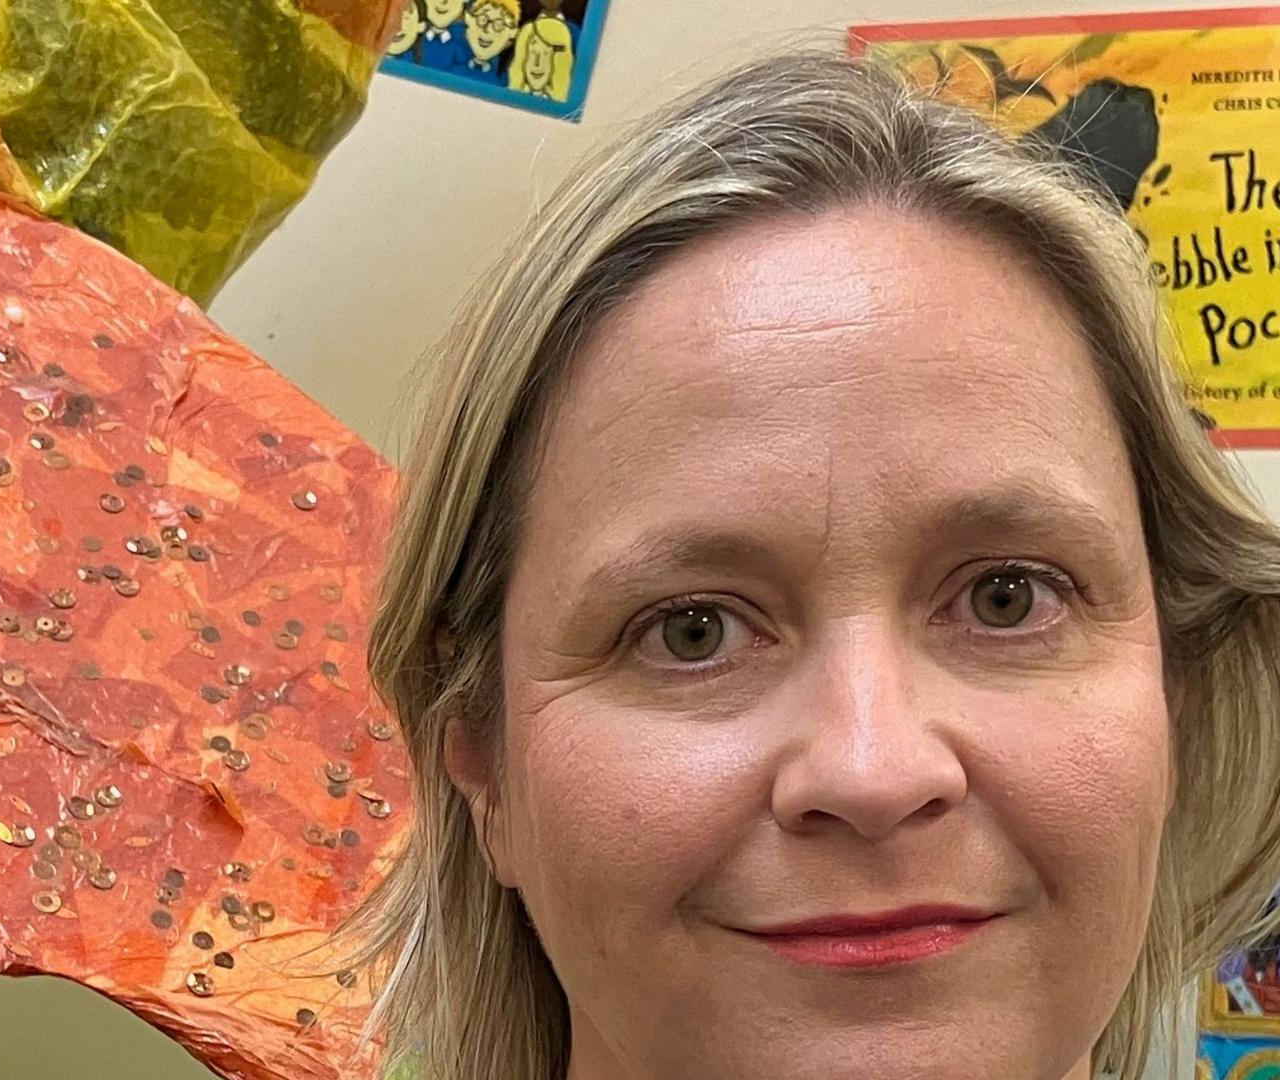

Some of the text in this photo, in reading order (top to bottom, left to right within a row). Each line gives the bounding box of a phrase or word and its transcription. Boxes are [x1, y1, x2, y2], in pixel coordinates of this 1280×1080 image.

[1191, 70, 1274, 85] MEREDITH
[1213, 97, 1262, 111] CHRIS
[1134, 226, 1253, 290] ebble
[1248, 381, 1268, 399] of
